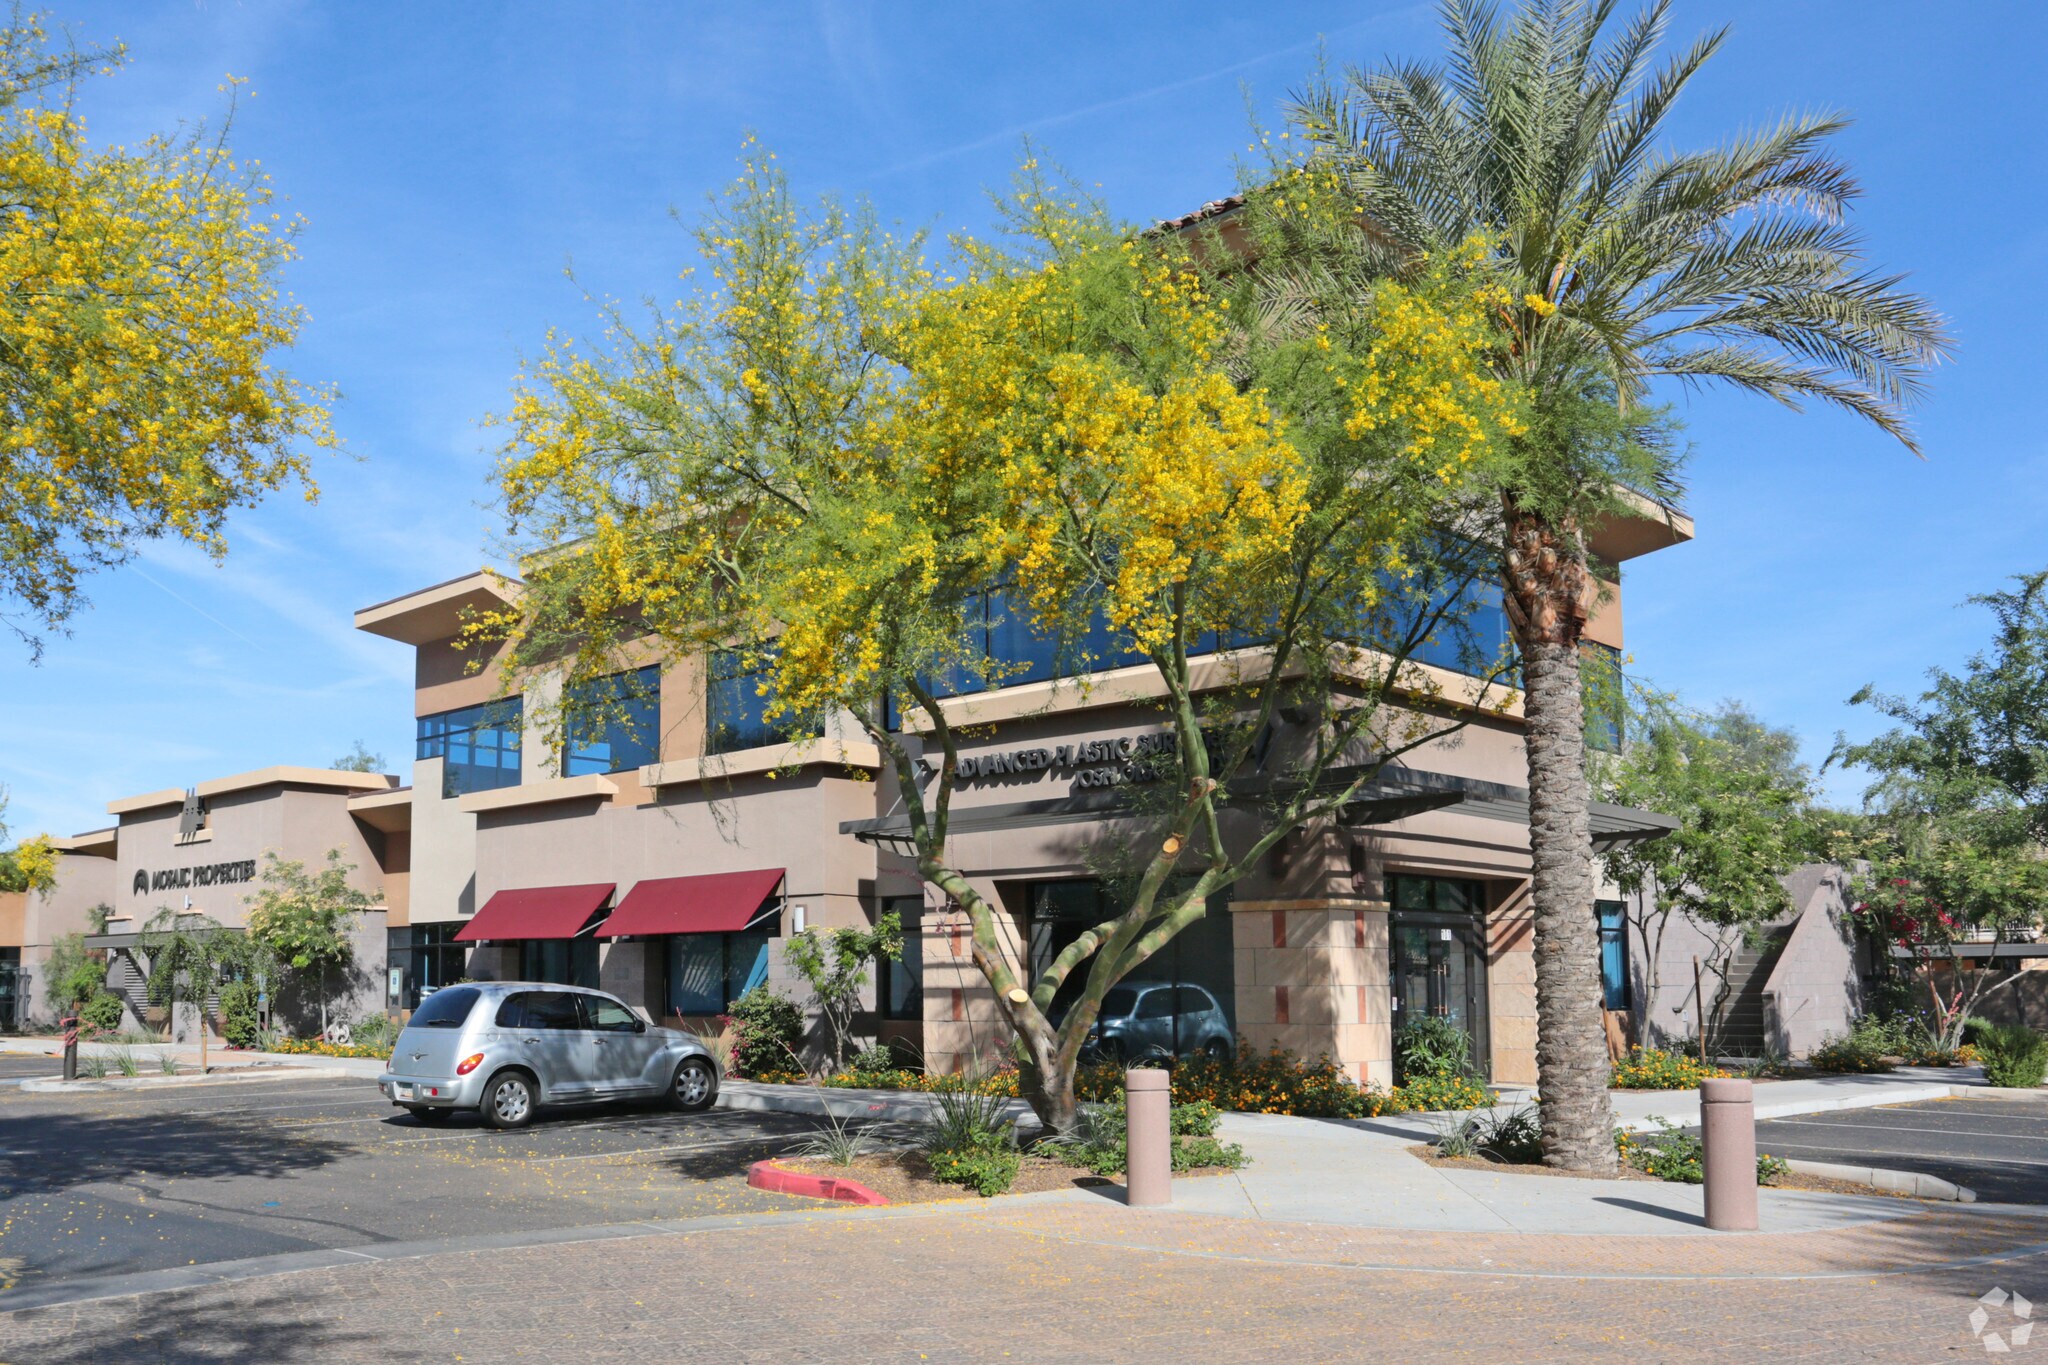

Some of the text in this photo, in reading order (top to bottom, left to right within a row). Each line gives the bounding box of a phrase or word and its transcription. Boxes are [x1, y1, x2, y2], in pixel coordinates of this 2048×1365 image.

[954, 748, 1053, 778] ADVANCED
[1056, 736, 1133, 766] PLASTIC
[1070, 766, 1118, 788] JOSH
[151, 859, 256, 891] MOSAIC PROPERTIES
